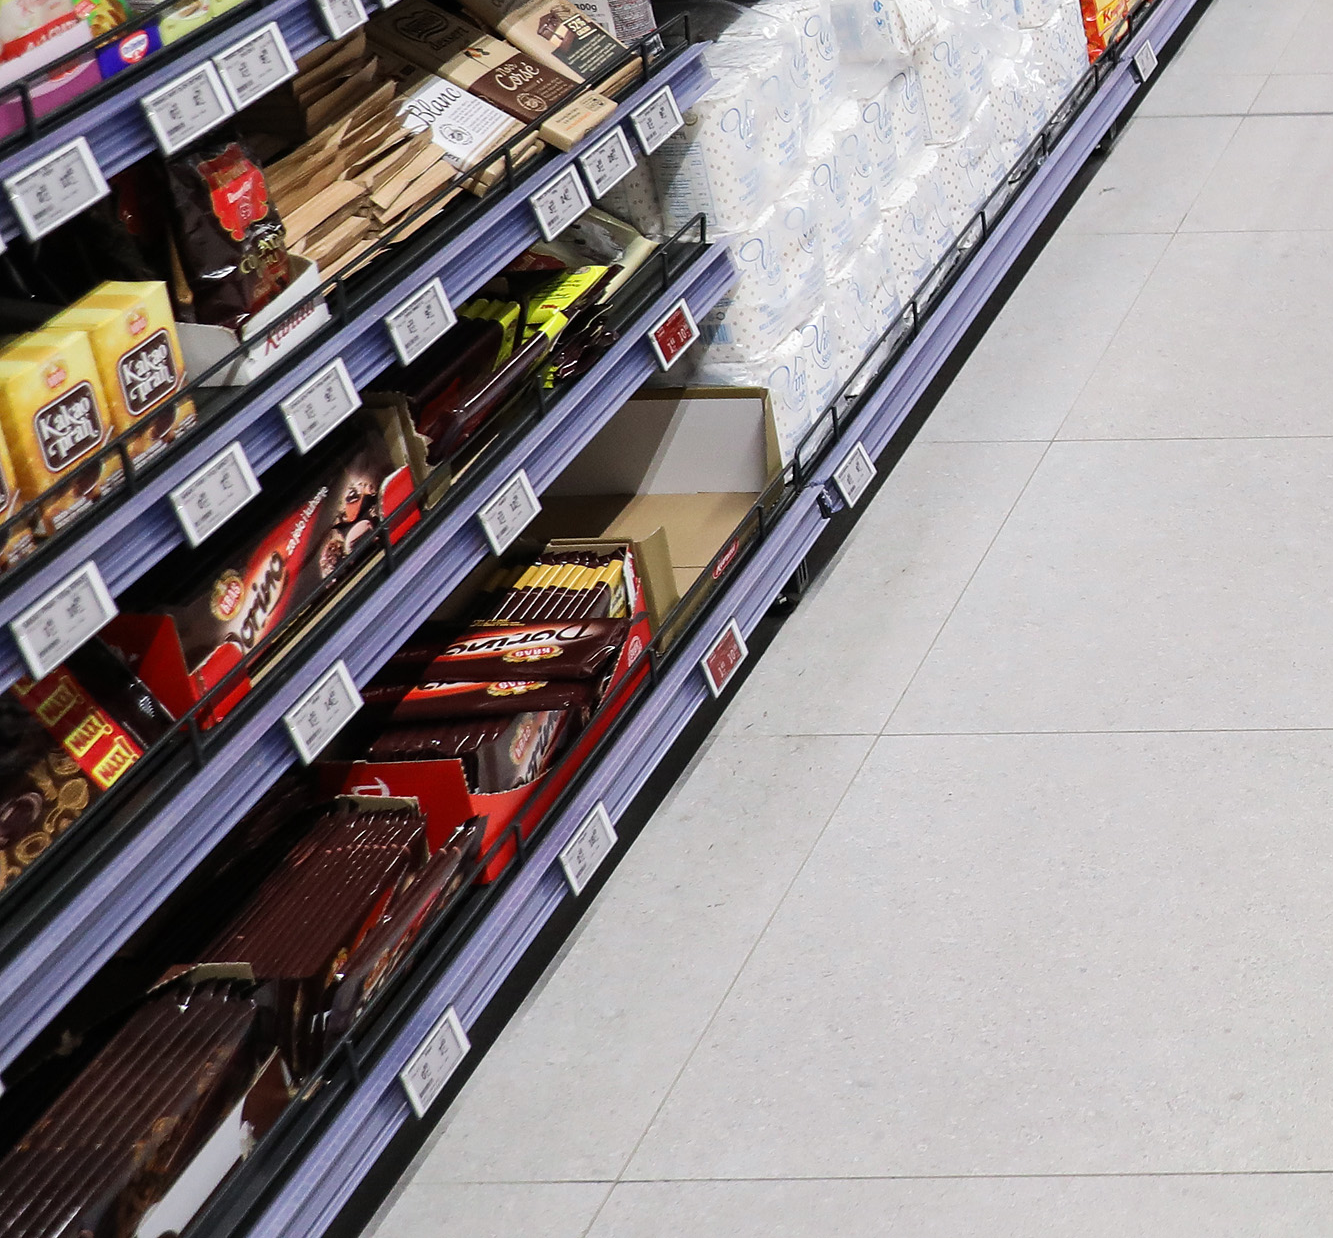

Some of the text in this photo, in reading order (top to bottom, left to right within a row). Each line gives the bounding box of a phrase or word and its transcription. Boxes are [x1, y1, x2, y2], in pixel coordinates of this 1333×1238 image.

[496, 62, 540, 92] Corsé
[415, 86, 462, 127] Blanc
[122, 343, 171, 382] Kakao
